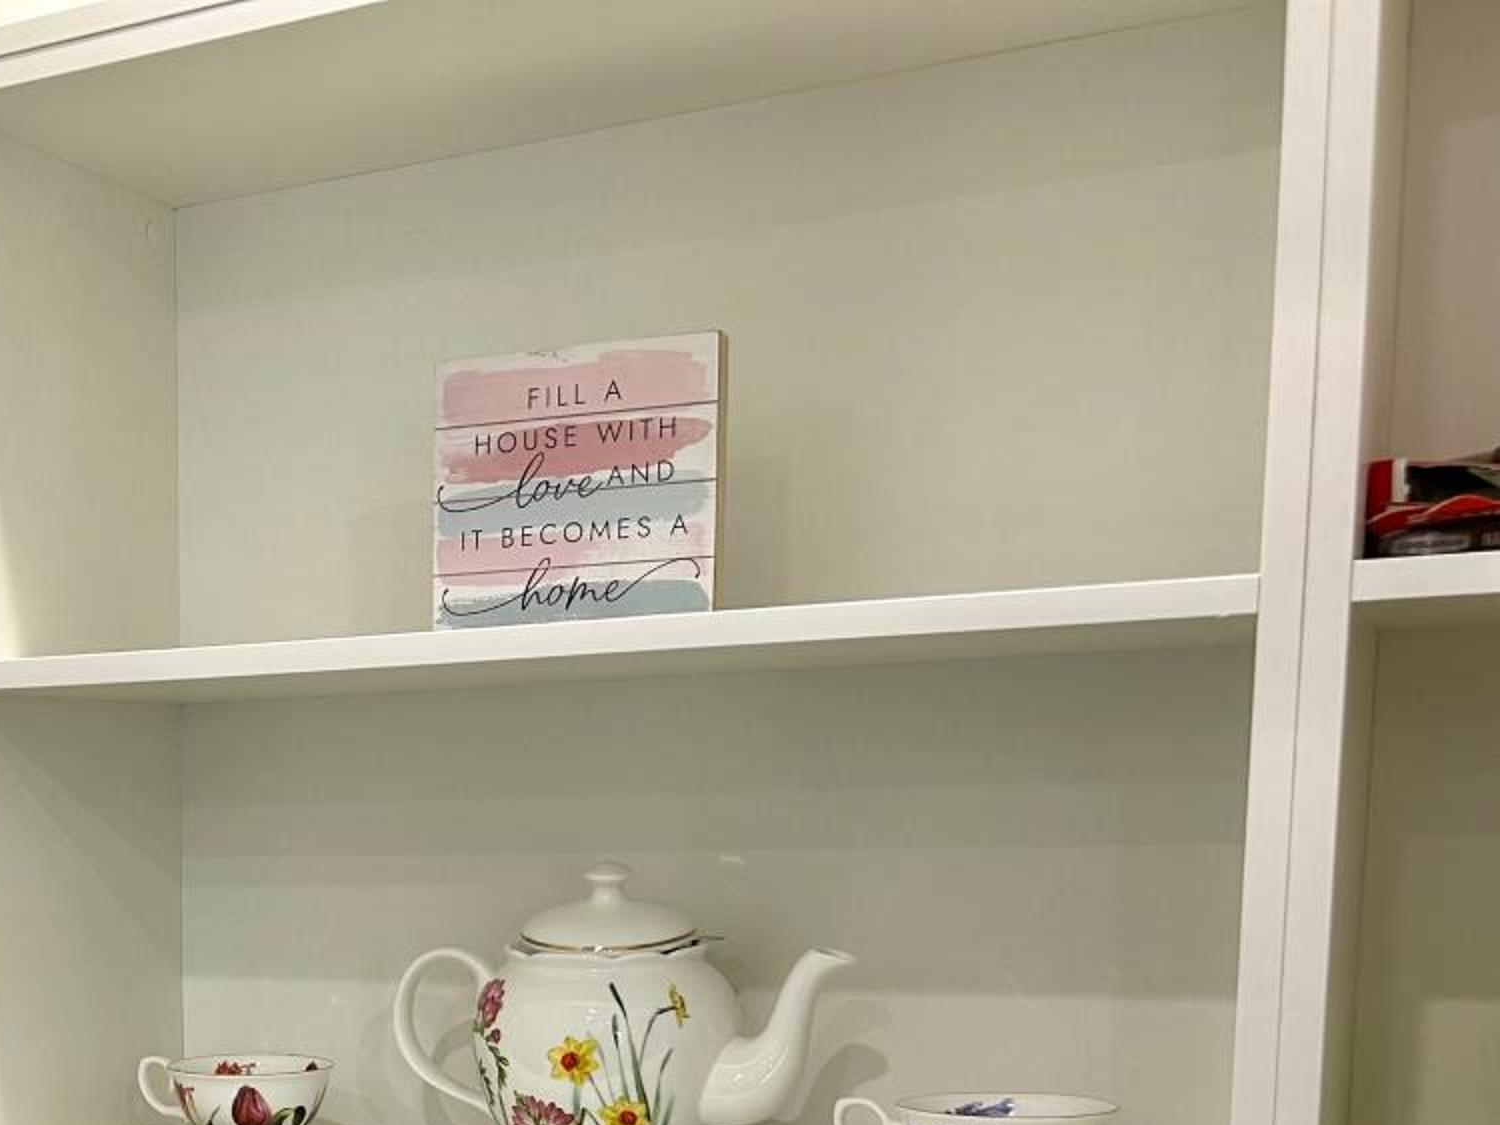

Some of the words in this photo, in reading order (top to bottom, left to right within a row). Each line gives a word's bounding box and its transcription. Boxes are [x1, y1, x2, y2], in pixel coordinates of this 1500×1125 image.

[527, 383, 587, 410] FILL
[603, 380, 623, 401] A
[474, 424, 578, 456] HOUSE
[597, 416, 678, 443] WITH
[438, 452, 603, 513] love
[607, 460, 675, 486] AND
[460, 529, 483, 551] IT
[501, 516, 651, 549] BECOMES
[669, 514, 689, 537] A
[442, 557, 701, 616] home
